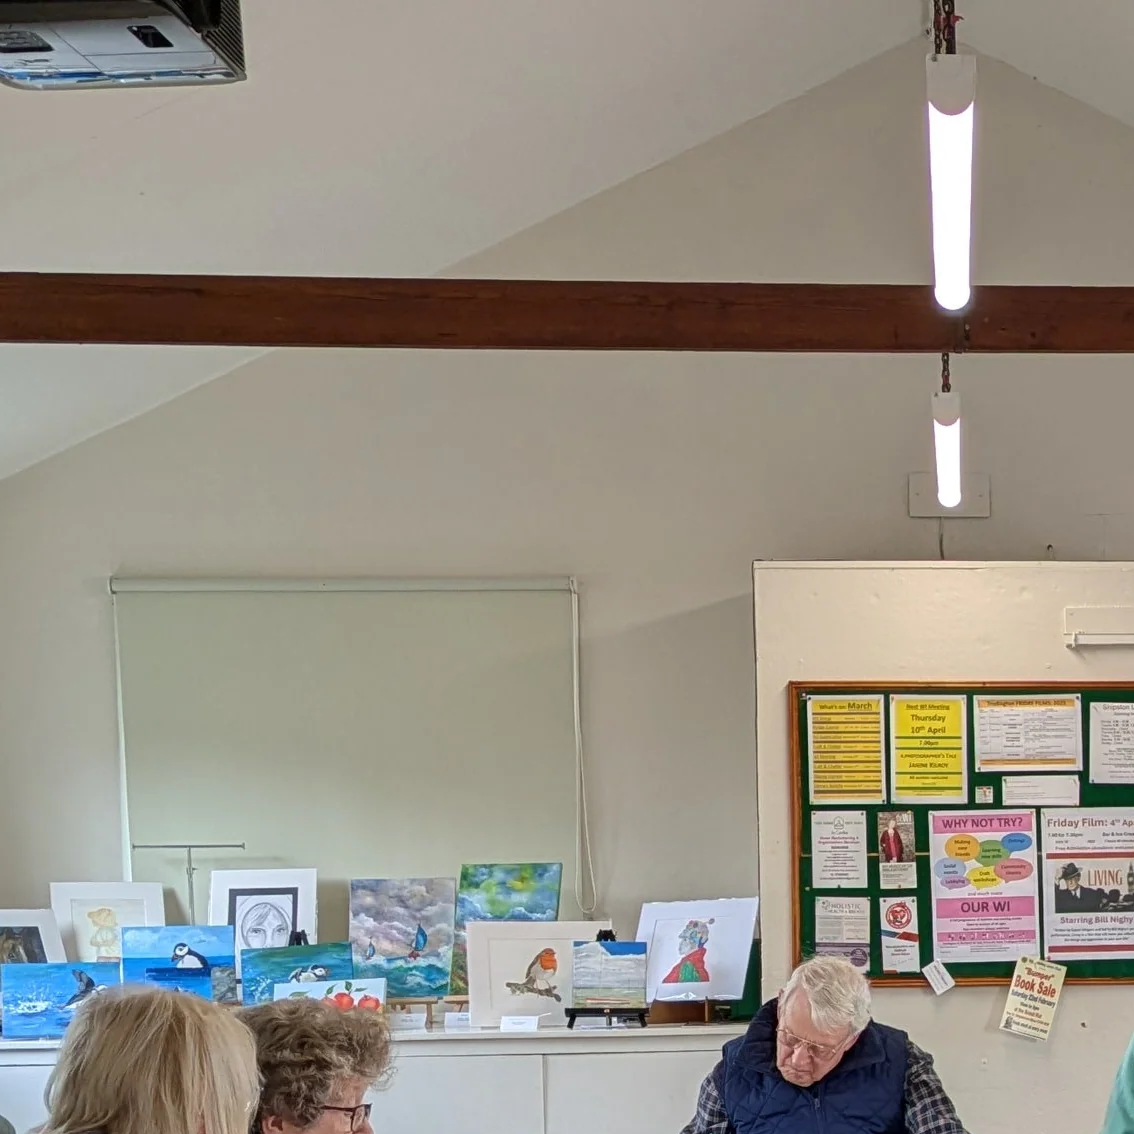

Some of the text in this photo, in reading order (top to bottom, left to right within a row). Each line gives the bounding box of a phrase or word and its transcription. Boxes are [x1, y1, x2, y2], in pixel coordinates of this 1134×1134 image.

[910, 714, 946, 723] Thursday
[928, 726, 946, 735] April
[942, 817, 1023, 829] WHY NOT TRY?
[1047, 818, 1079, 829] Friday
[1082, 818, 1107, 826] Film:
[1087, 869, 1123, 886] LIVING
[961, 901, 1010, 913] OUR WI
[1110, 916, 1134, 924] Nighy
[1014, 974, 1056, 998] Book Sale
[1011, 990, 1028, 1000] Saturday
[1038, 997, 1056, 1008] February
